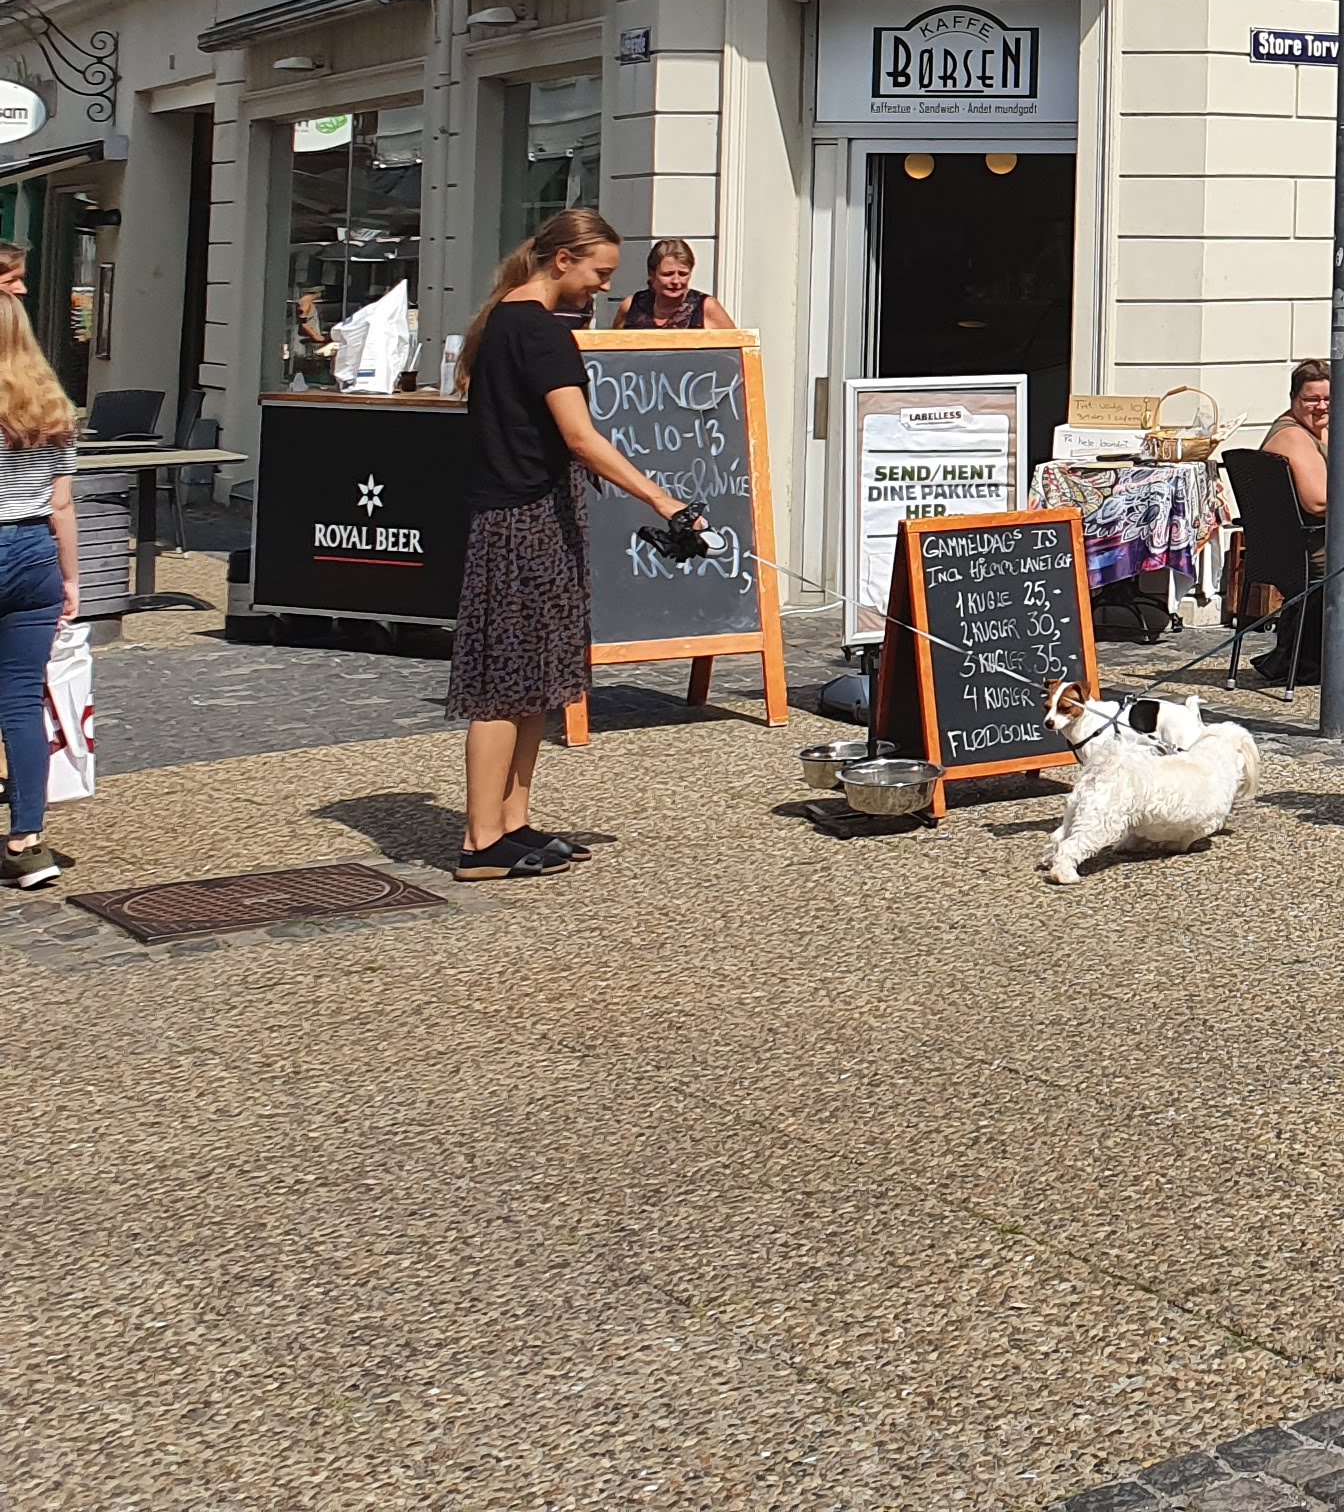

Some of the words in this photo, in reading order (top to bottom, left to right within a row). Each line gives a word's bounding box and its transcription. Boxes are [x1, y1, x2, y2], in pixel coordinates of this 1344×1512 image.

[919, 16, 994, 39] KAFFE
[1258, 32, 1302, 55] Store
[1305, 35, 1339, 58] Torv
[886, 35, 1021, 89] BØRSEN
[871, 102, 911, 114] Kaffestue
[919, 102, 960, 114] Sandwich
[587, 361, 744, 420] BRUNCH
[909, 411, 962, 422] LABELLESS
[655, 419, 726, 457] 10-13
[874, 464, 997, 482] SEND/HENT
[868, 485, 917, 502] DINE
[921, 483, 1002, 500] PAKKER
[314, 523, 372, 550] ROYAL
[375, 527, 424, 554] BEER
[1031, 529, 1057, 549] IS
[955, 591, 964, 617] 1
[967, 591, 1012, 615] KUGLE
[963, 685, 978, 712] 4
[984, 687, 1035, 710] KUGLER
